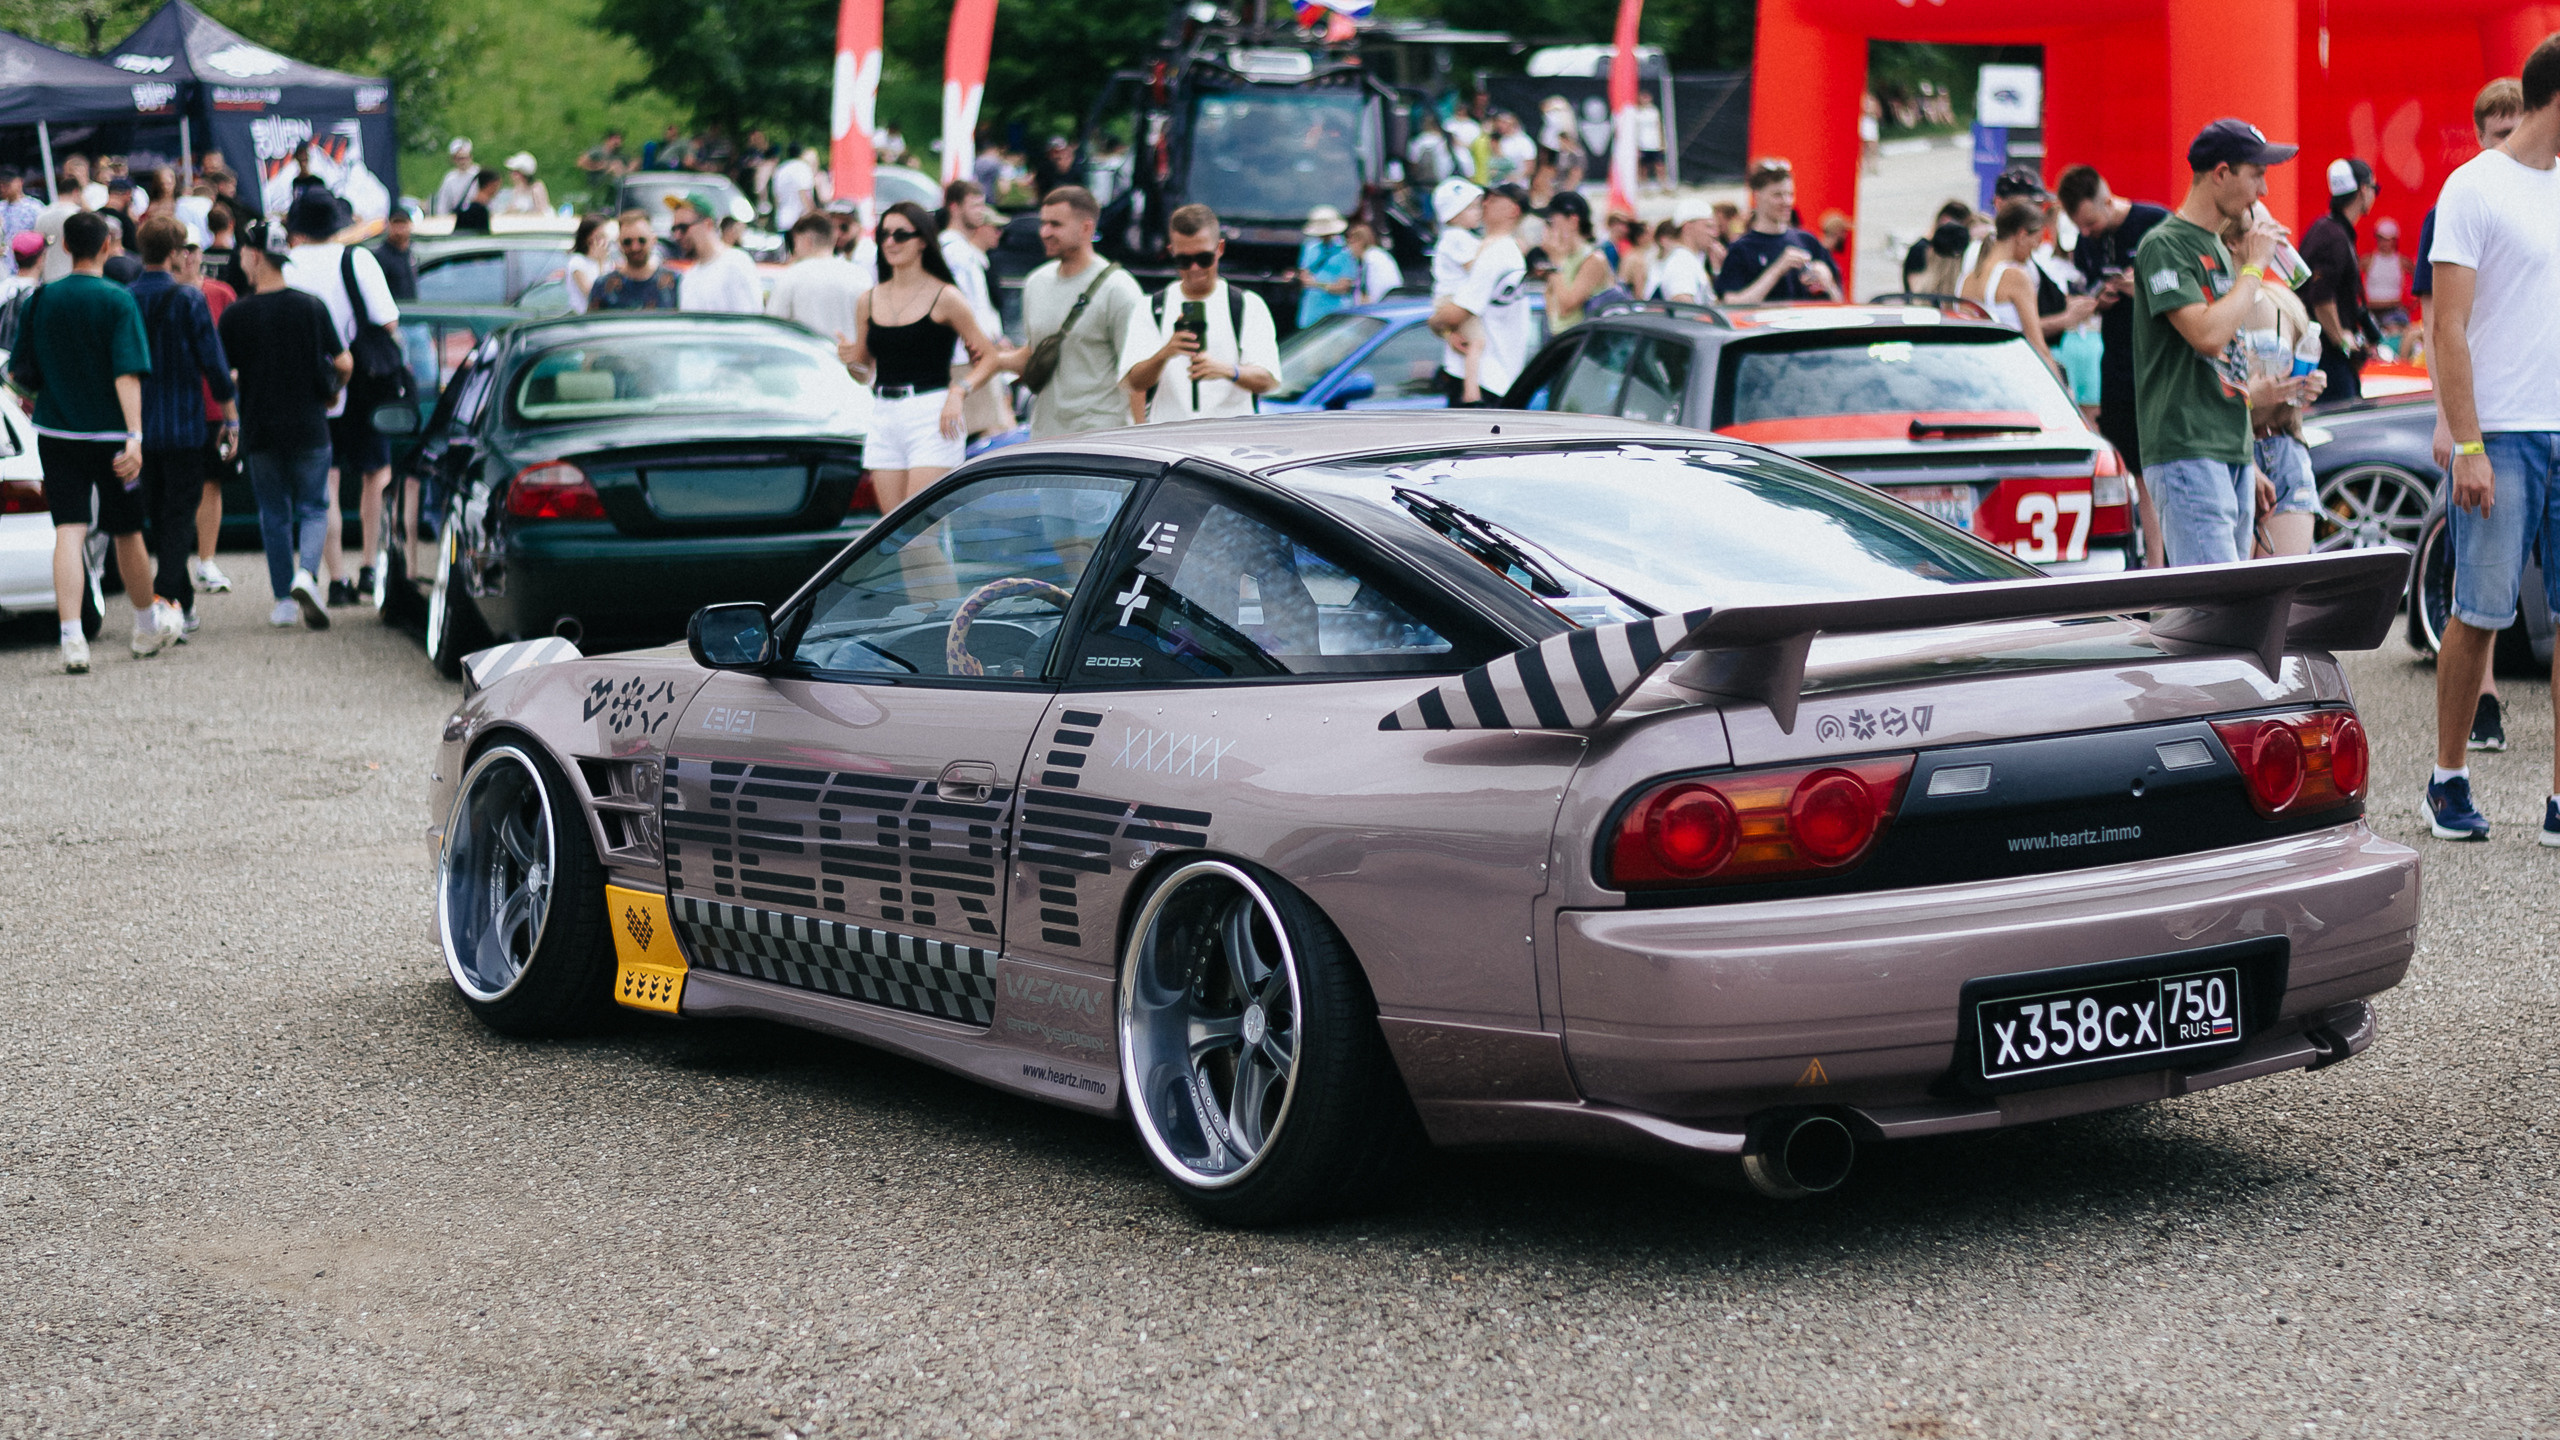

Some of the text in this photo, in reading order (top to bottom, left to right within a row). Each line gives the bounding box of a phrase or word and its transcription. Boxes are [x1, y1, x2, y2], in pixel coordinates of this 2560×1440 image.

[2015, 490, 2092, 563] 37
[1085, 656, 1143, 668] 200SX
[702, 706, 757, 735] LEVEL
[2007, 823, 2142, 852] www.heartz.immo
[1994, 976, 2226, 1067] X358CX 750
[2179, 1021, 2211, 1040] RUS
[1022, 1062, 1107, 1095] www.heartz.immo
